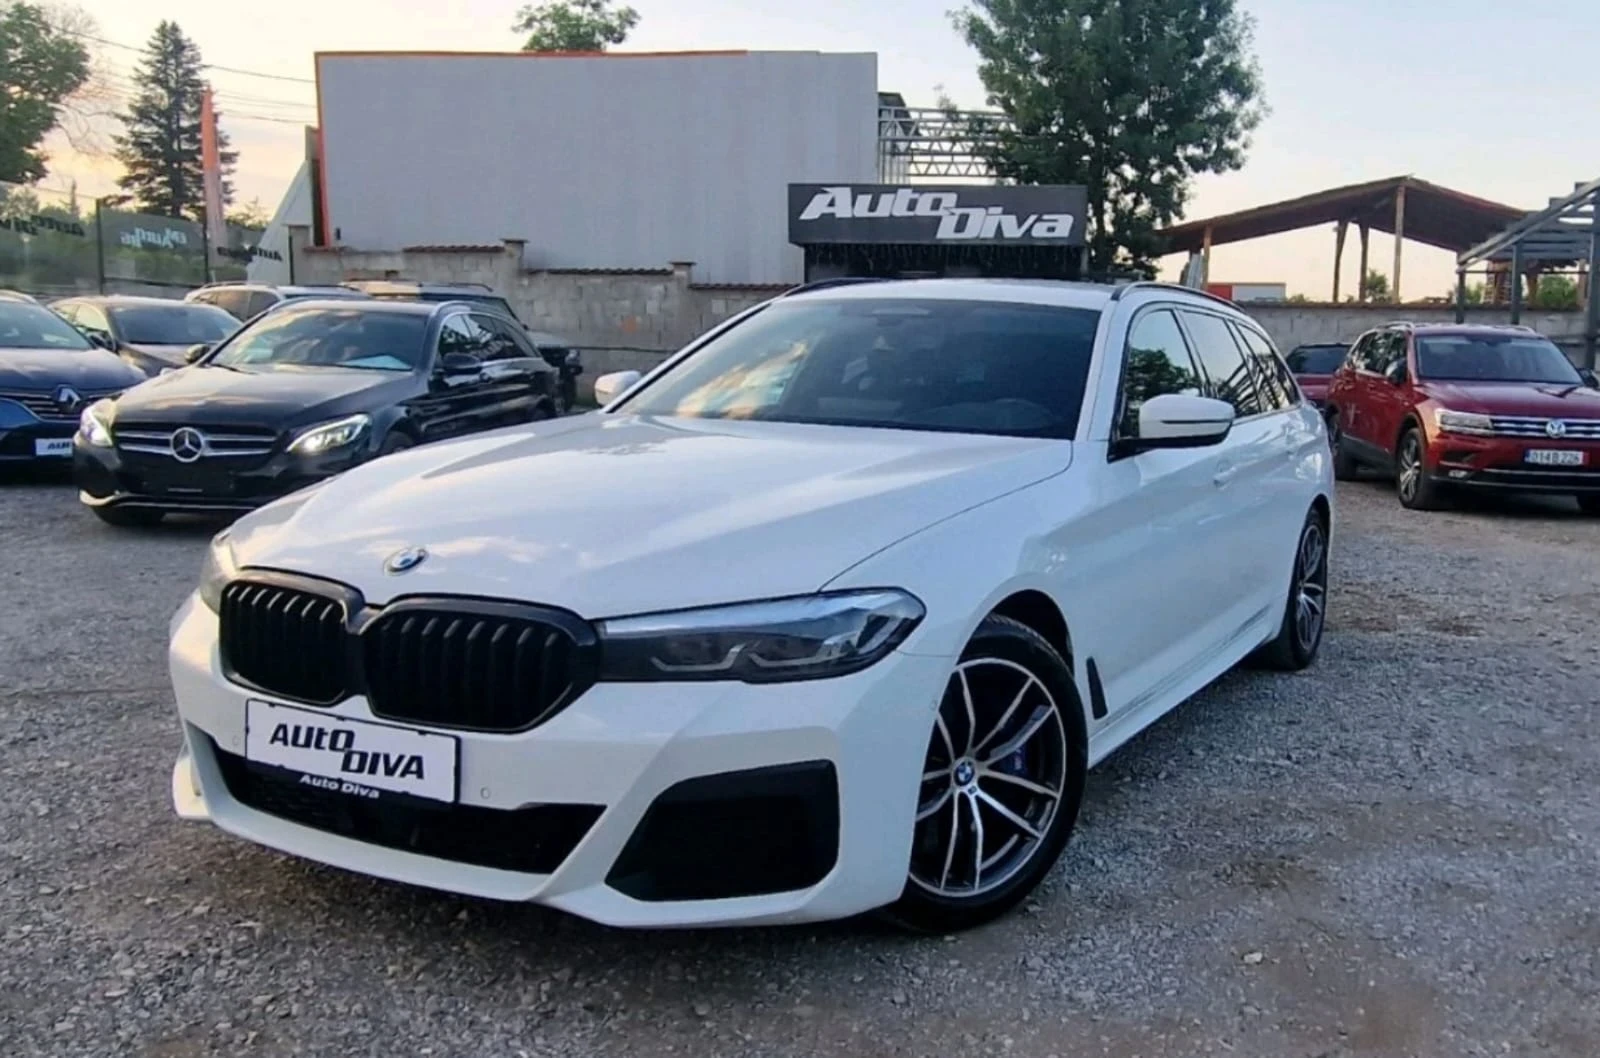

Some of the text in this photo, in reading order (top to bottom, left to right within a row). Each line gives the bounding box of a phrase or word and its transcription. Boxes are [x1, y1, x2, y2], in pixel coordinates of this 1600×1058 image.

[799, 187, 957, 220] Auto
[936, 206, 1074, 239] Diva
[341, 750, 425, 780] DIVA
[300, 774, 380, 799] Auto Diva
